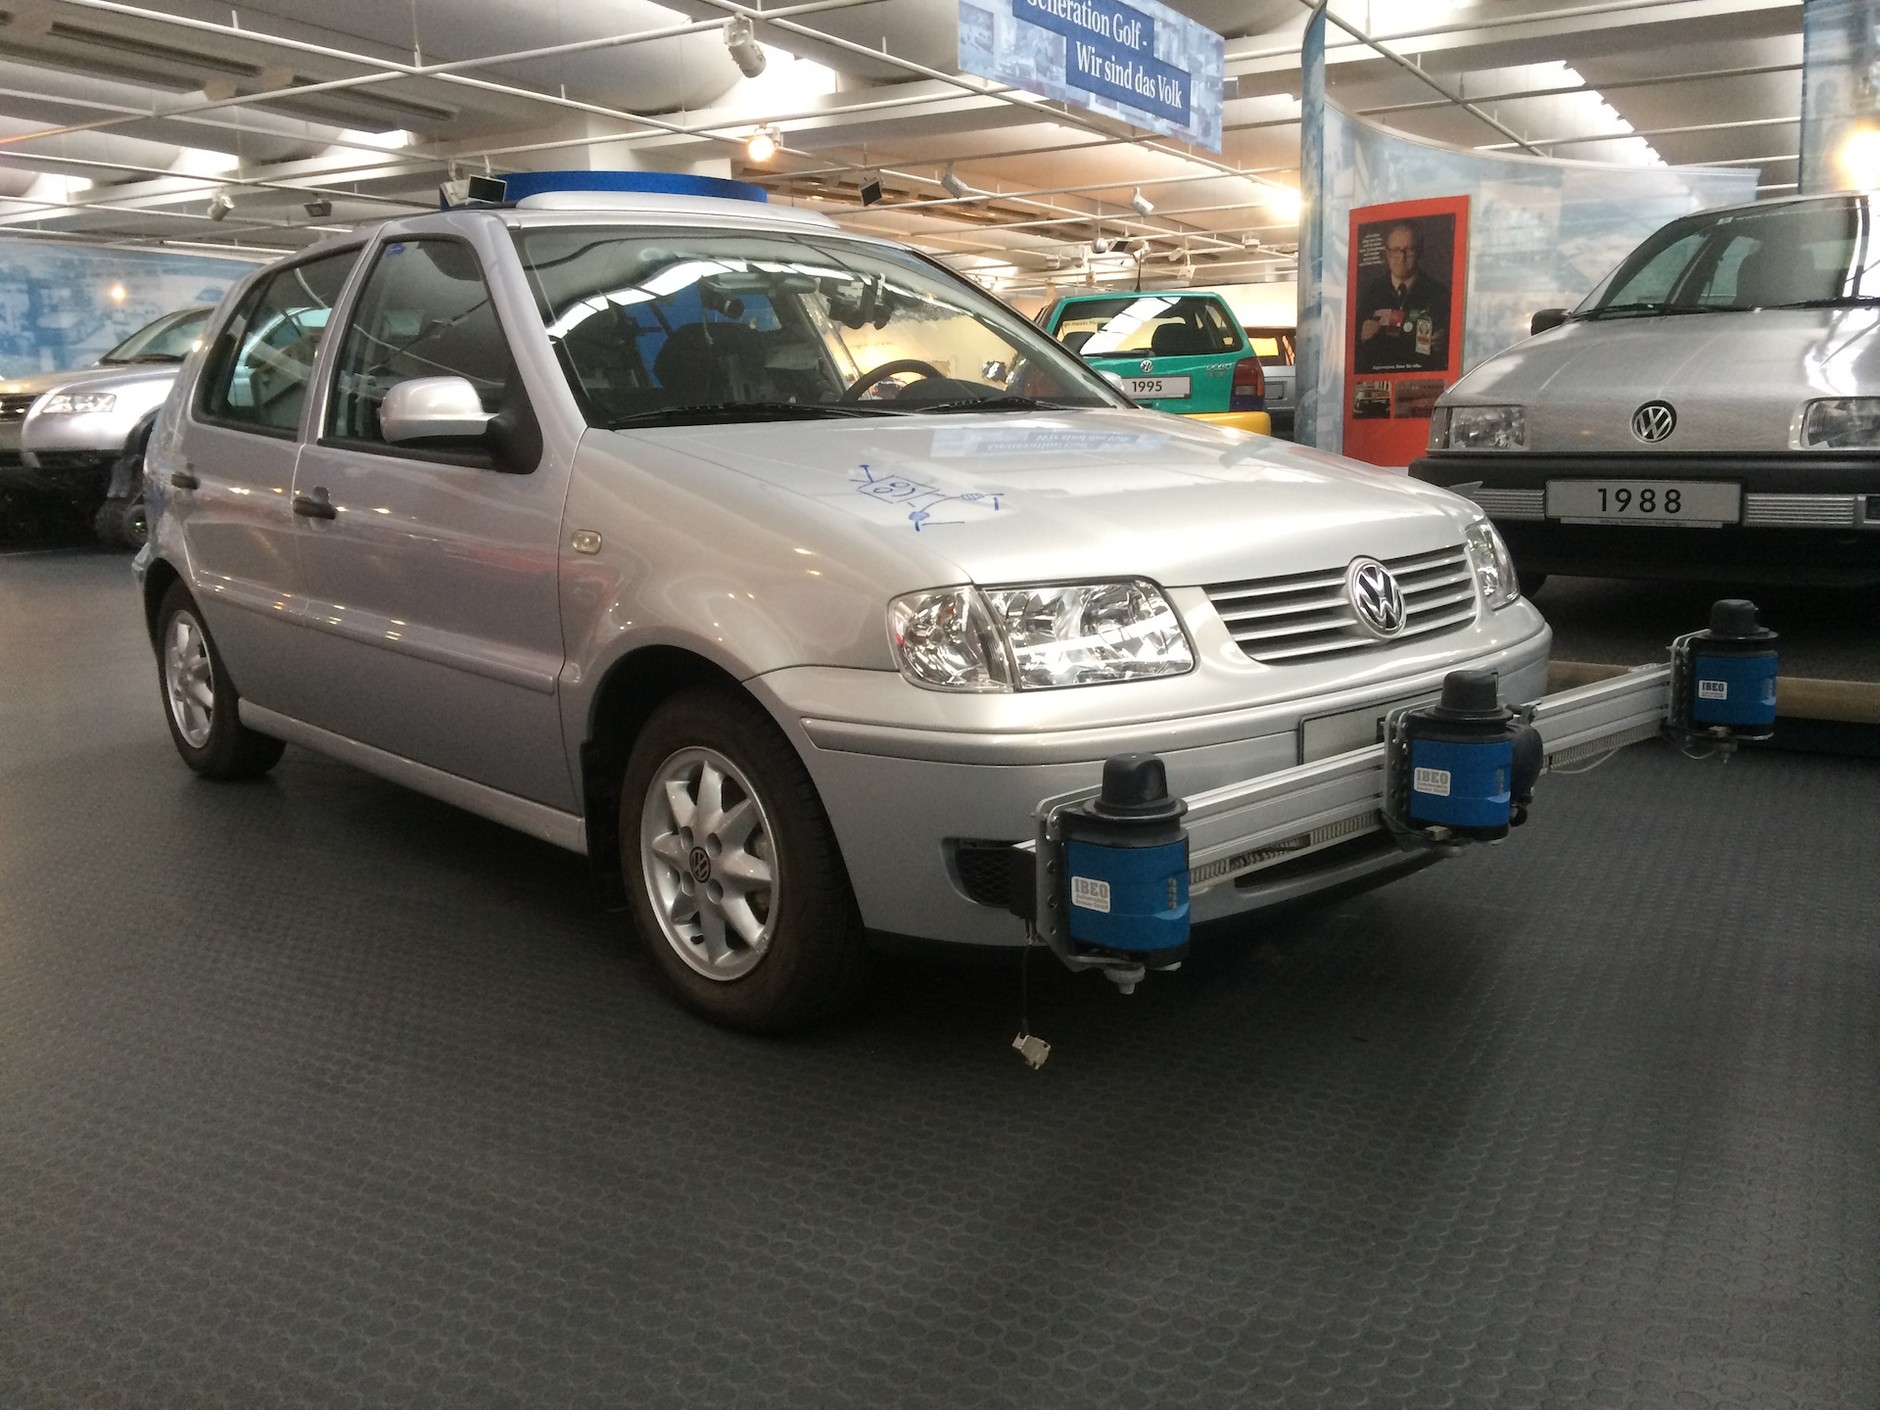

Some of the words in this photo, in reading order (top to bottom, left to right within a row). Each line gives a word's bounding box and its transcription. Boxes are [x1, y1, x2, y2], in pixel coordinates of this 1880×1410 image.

[1027, 0, 1110, 37] neration
[1113, 13, 1141, 50] Golf
[1076, 41, 1102, 77] Wir
[1104, 54, 1133, 90] sind
[1135, 65, 1156, 98] das
[1157, 74, 1182, 109] Volk
[1132, 380, 1163, 393] 1995
[1597, 488, 1681, 514] 1988
[1702, 681, 1724, 692] IBEO
[1416, 768, 1449, 785] IBEO
[1075, 877, 1108, 899] IBEO
